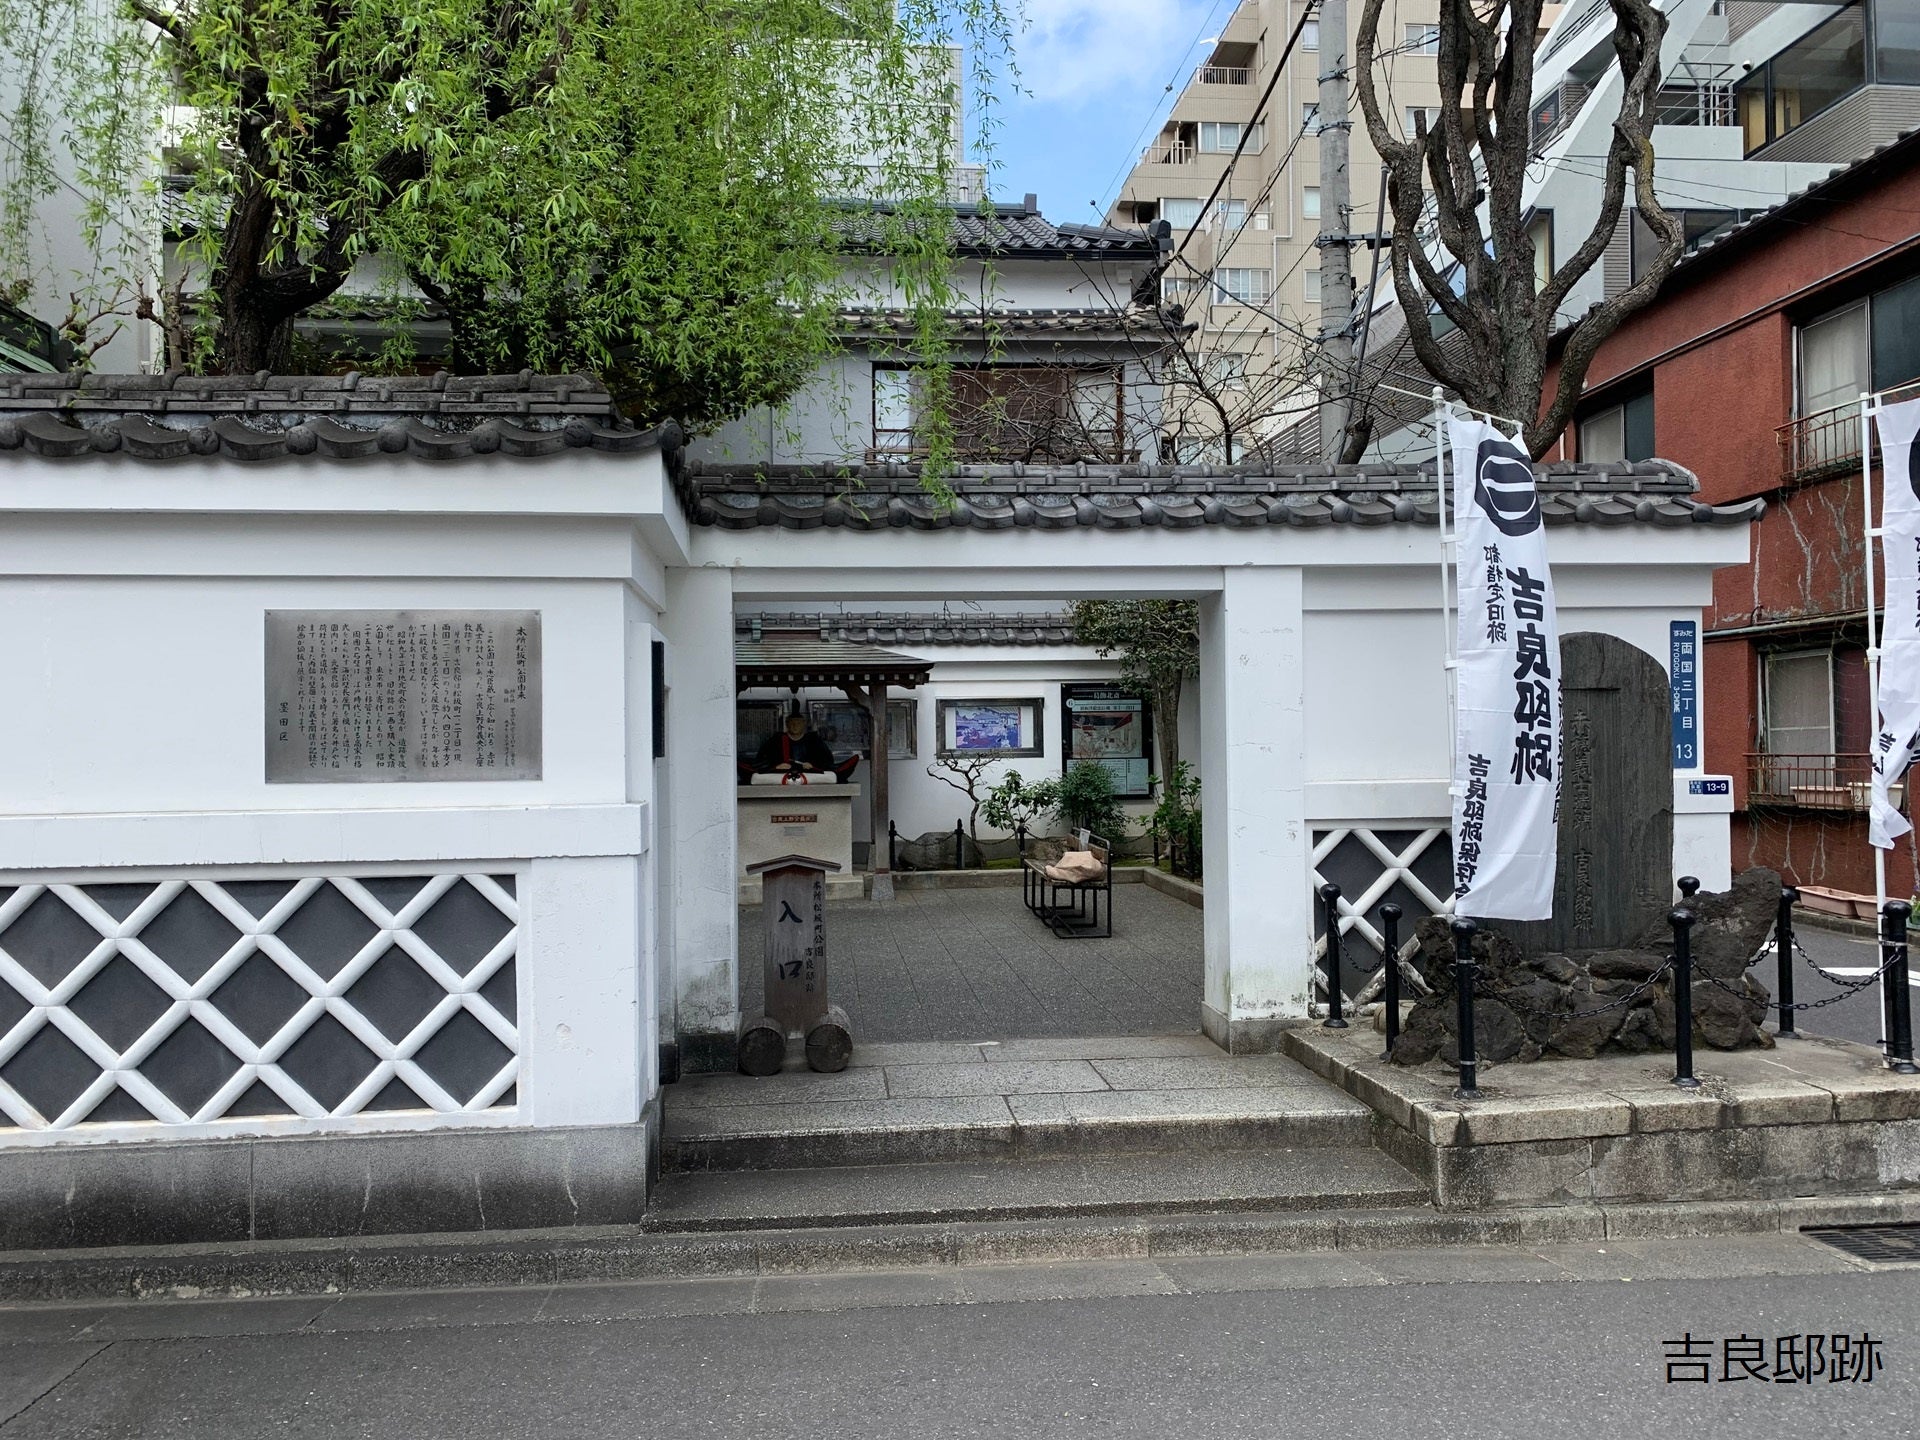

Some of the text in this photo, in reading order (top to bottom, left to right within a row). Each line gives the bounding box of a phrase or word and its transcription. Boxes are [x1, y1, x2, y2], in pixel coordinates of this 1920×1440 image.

[1673, 686, 1681, 713] 3-CHOME
[1681, 642, 1693, 729] 両国三丁目
[279, 702, 289, 742] 墨田区
[1676, 744, 1693, 759] 13
[1706, 783, 1727, 791] 13-9
[778, 900, 803, 980] 入口
